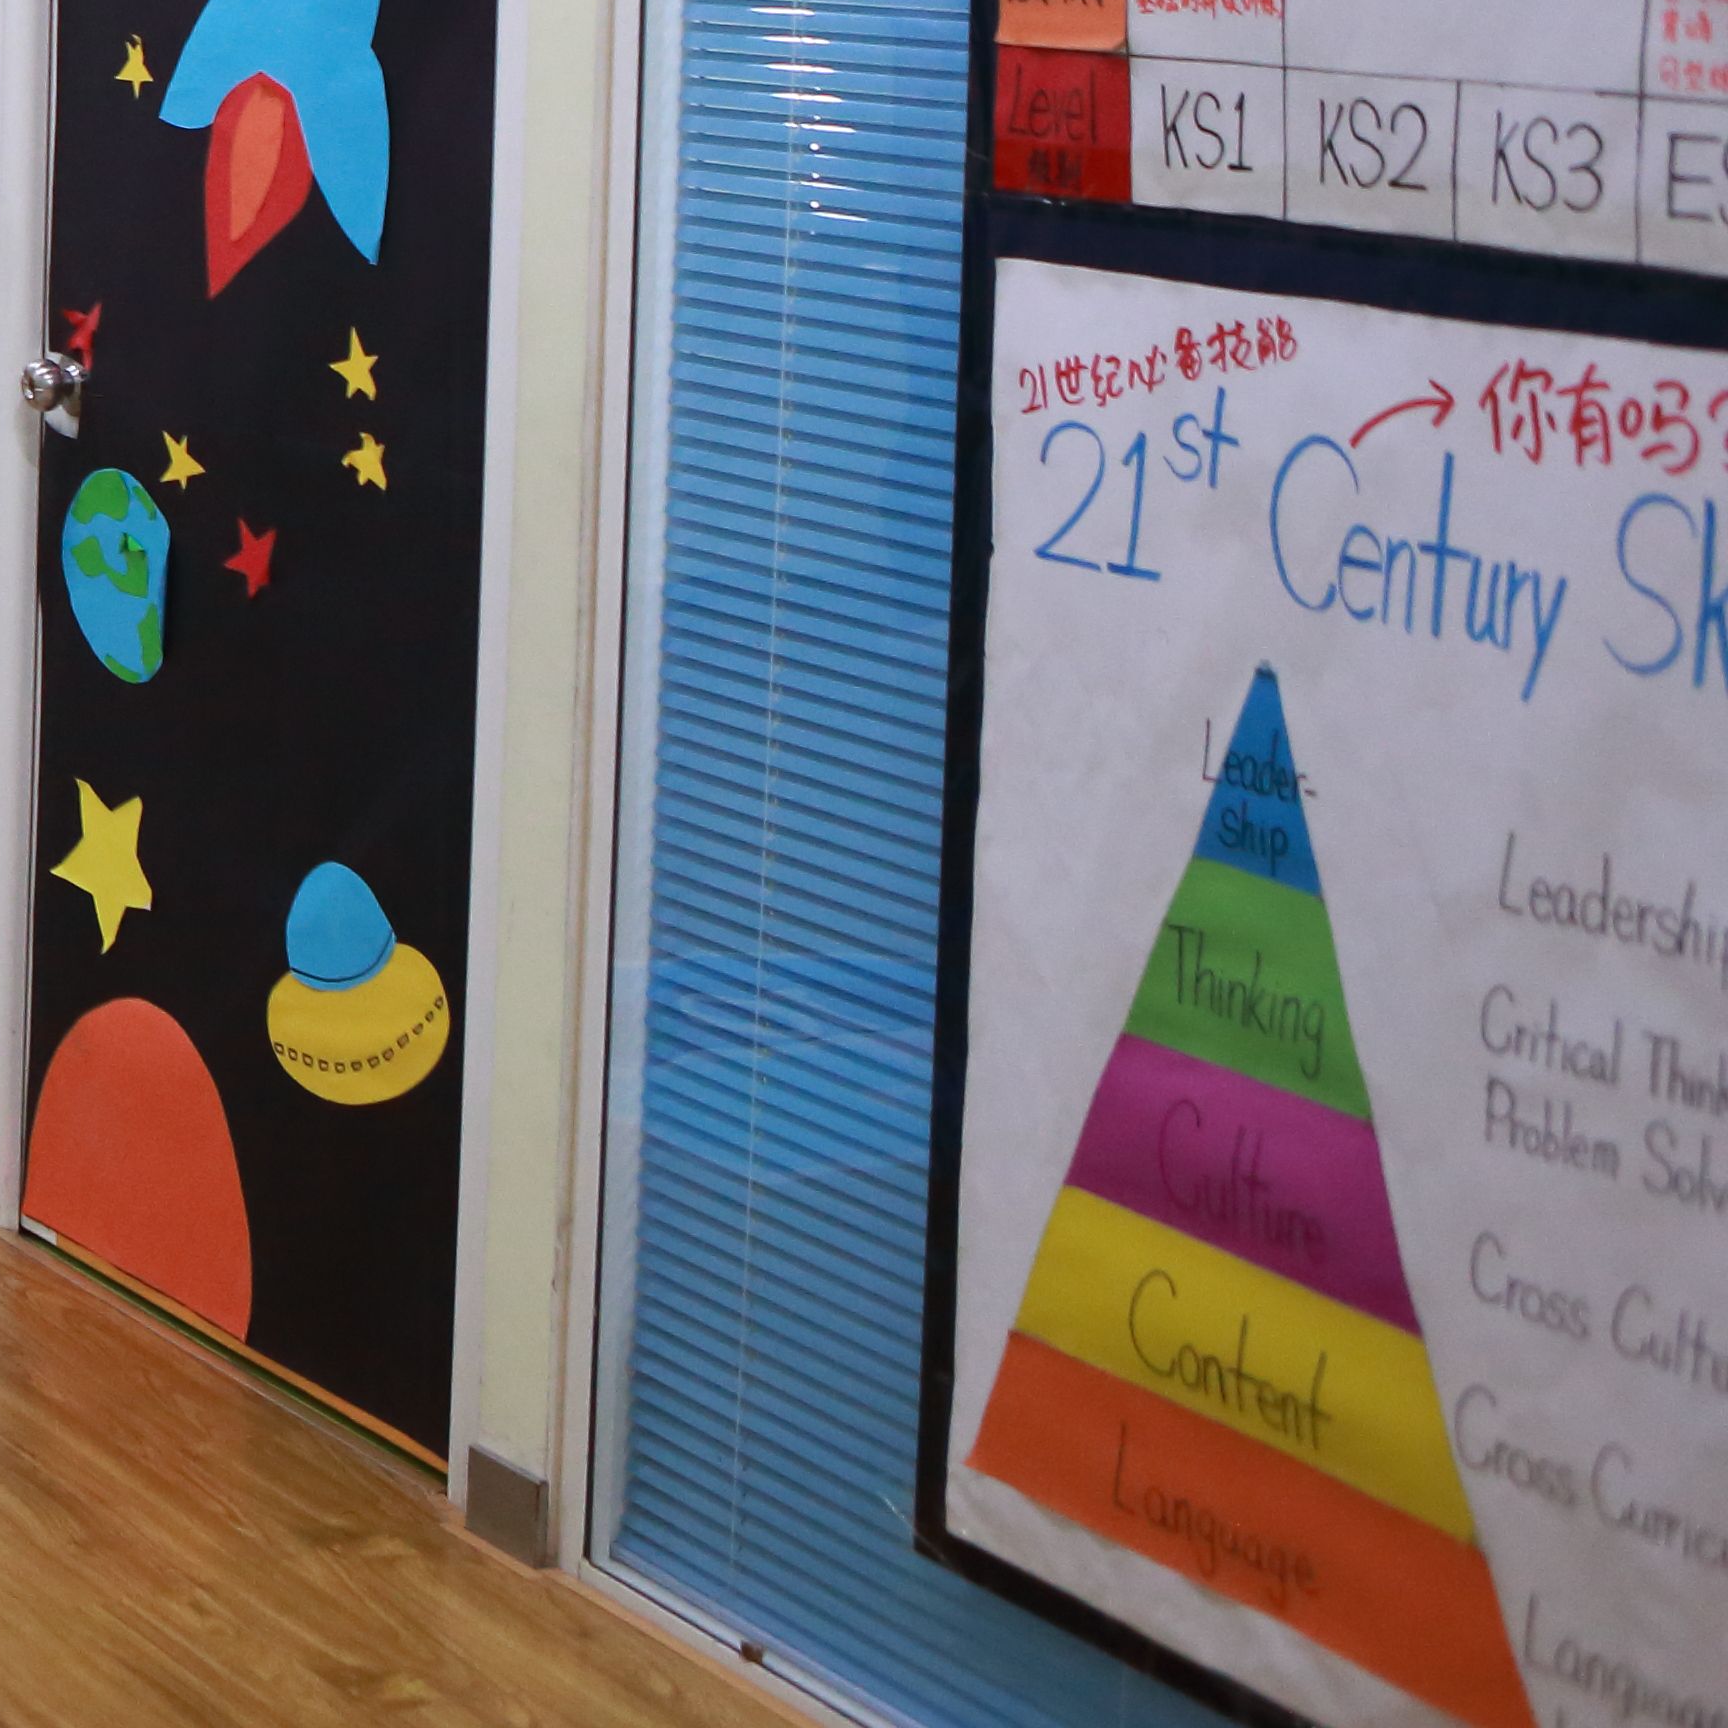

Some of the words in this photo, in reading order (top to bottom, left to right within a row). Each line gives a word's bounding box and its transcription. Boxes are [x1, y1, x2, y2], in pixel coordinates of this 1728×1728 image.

[1008, 63, 1097, 144] Level
[1161, 84, 1254, 173] KS1
[1319, 97, 1429, 192] KS2
[1492, 109, 1604, 212] KS3
[1667, 132, 1728, 224] E
[1019, 315, 1299, 415] 21世纪必备技能
[1033, 385, 1240, 582] 21st
[1269, 434, 1568, 703] Century
[1217, 806, 1290, 876] ship
[1167, 922, 1325, 1080] Thinking
[1481, 983, 1623, 1087] Critical
[1485, 1076, 1620, 1179] Problem
[1160, 1099, 1326, 1264] Culture
[1469, 1230, 1590, 1340] Cross
[1128, 1269, 1333, 1450] Content
[1454, 1382, 1577, 1507] Cross
[1111, 1420, 1321, 1612] Language
